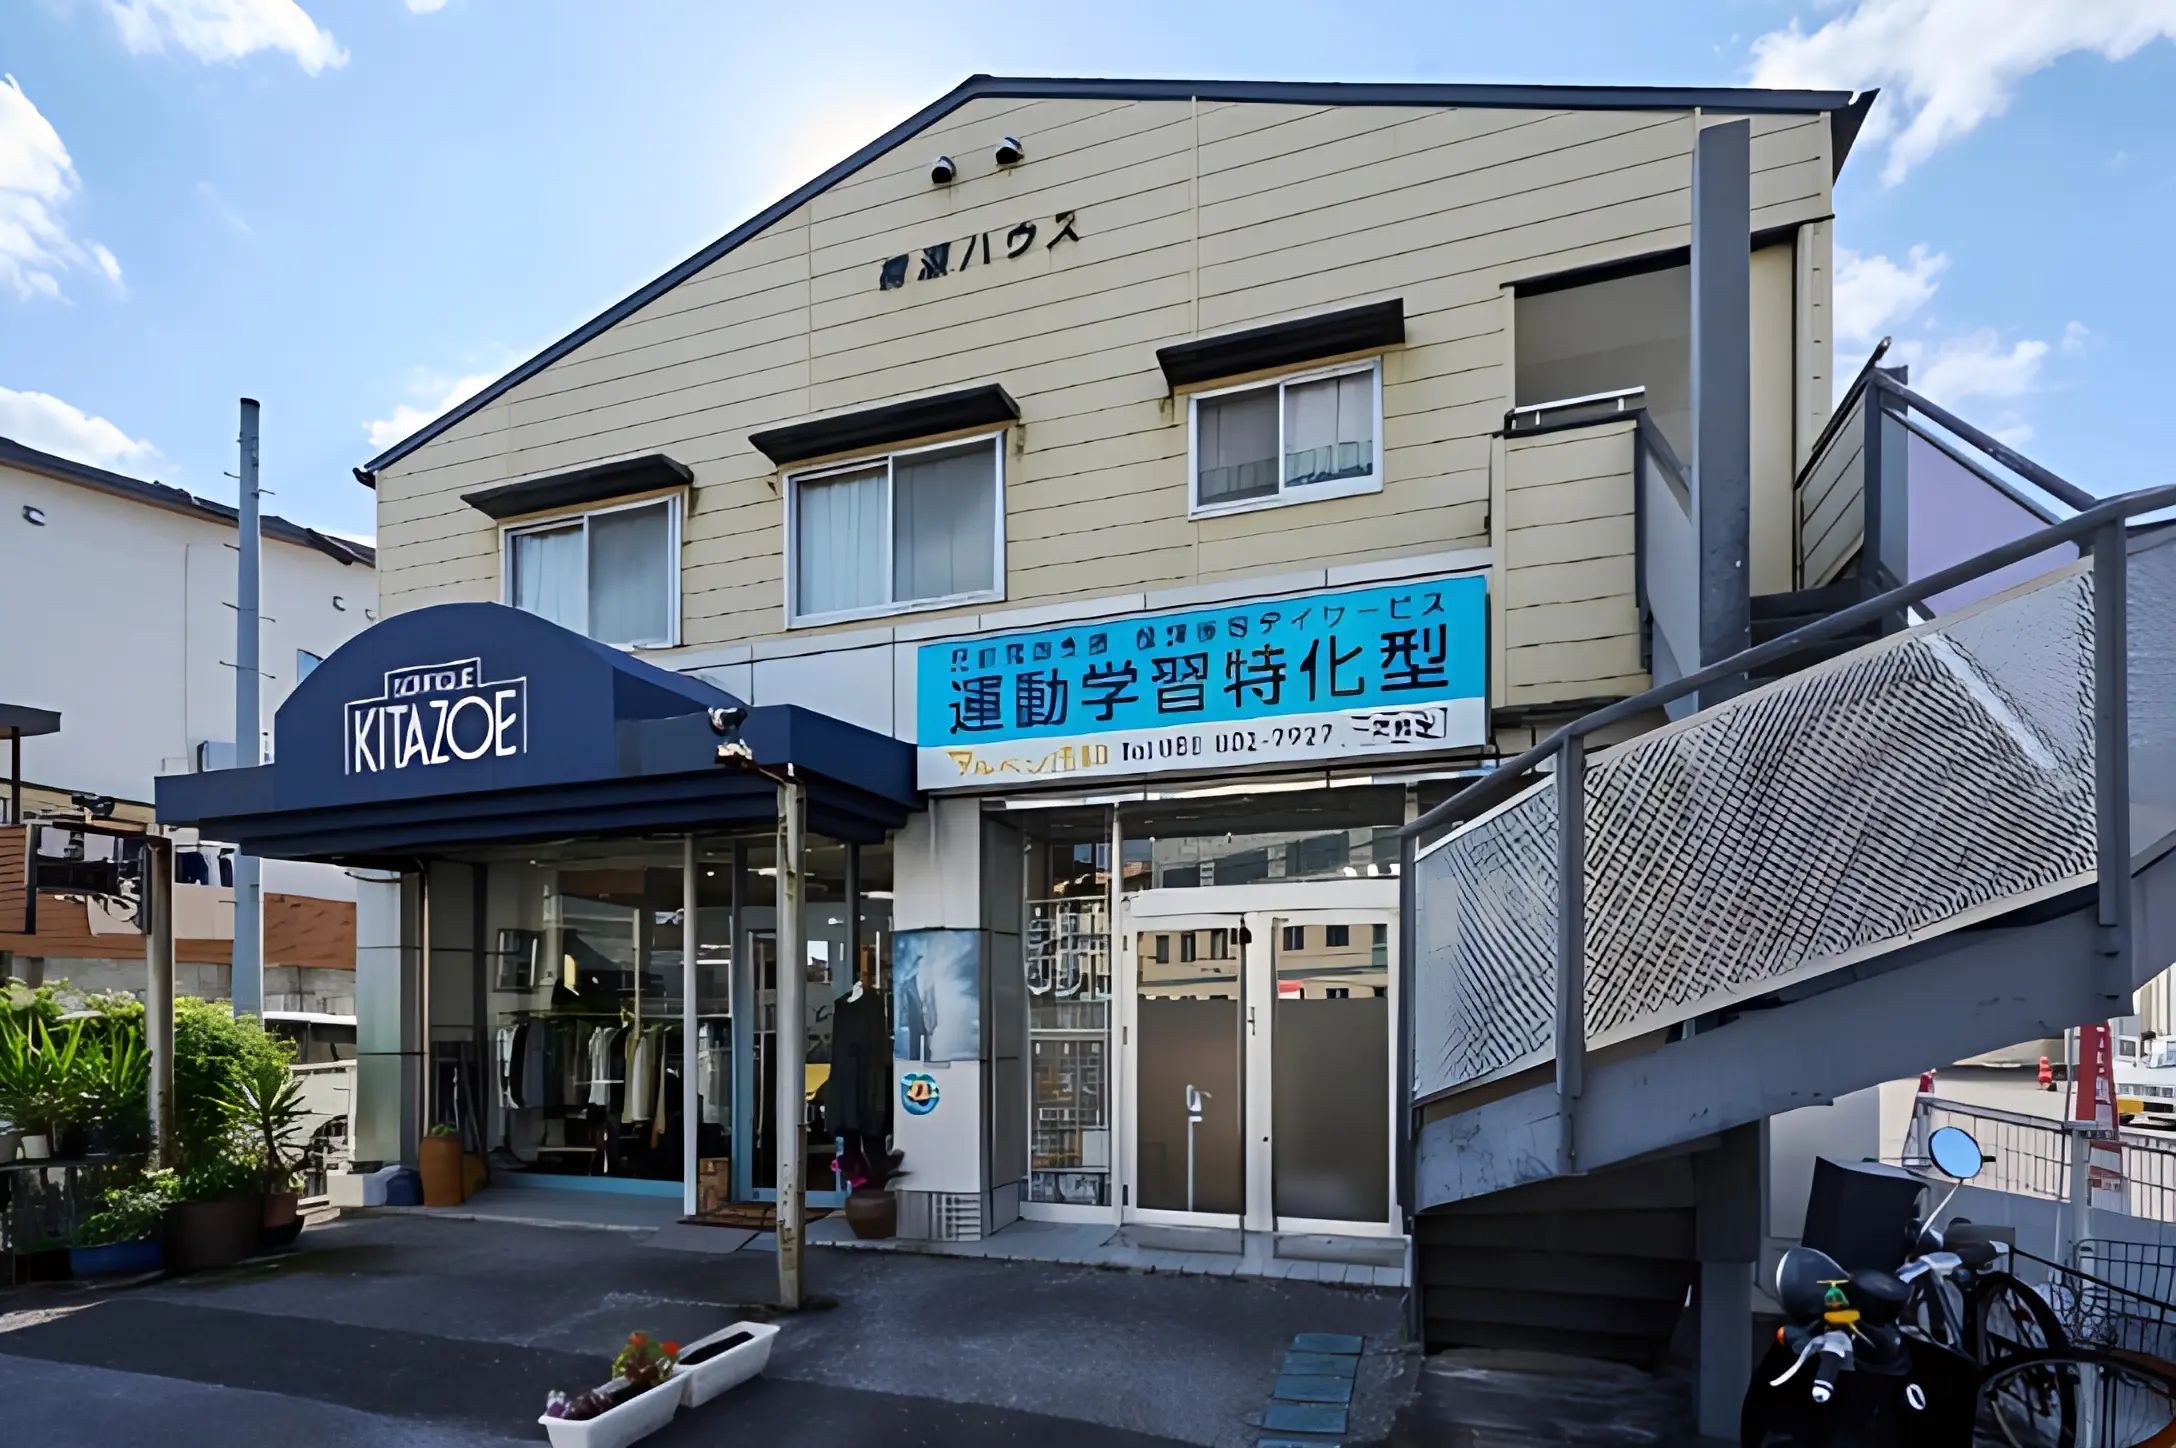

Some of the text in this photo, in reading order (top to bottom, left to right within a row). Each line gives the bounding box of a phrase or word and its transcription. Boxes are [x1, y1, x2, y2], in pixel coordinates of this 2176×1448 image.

[880, 211, 1080, 291] ハウス
[950, 624, 1448, 735] 運動学習特化型
[355, 689, 517, 773] KITAZOE
